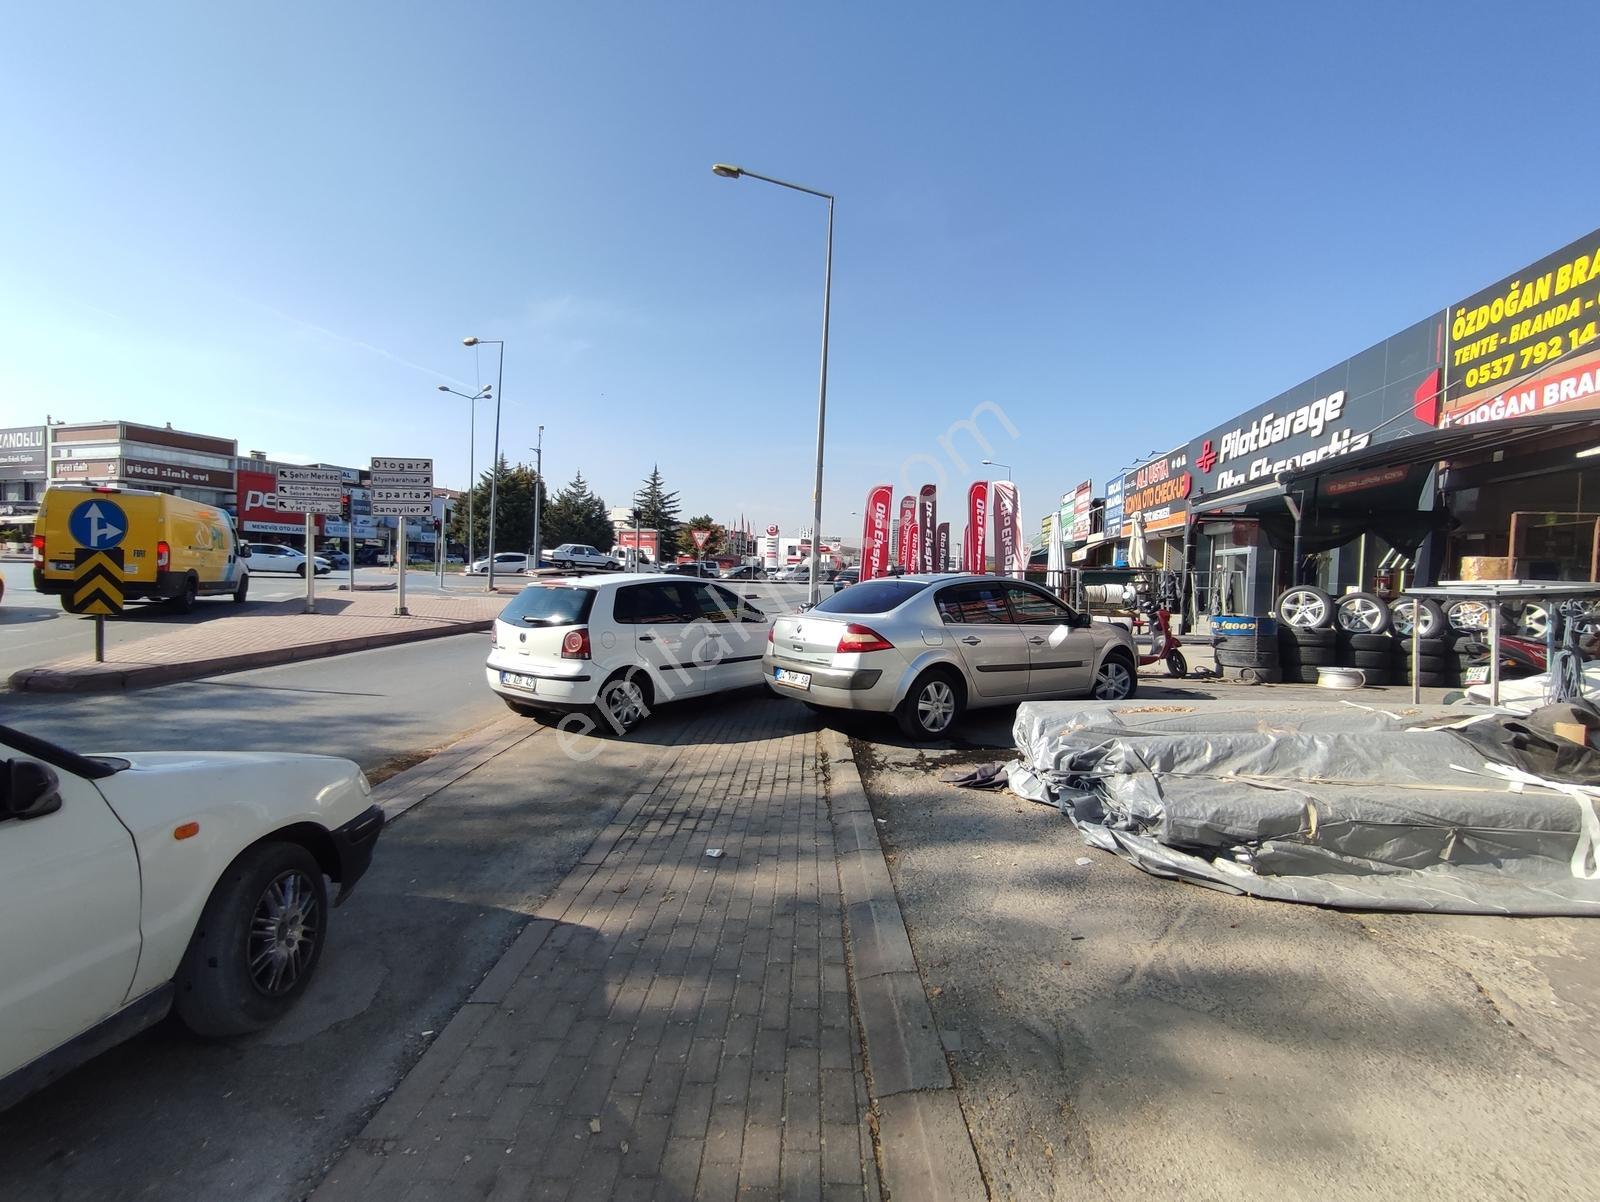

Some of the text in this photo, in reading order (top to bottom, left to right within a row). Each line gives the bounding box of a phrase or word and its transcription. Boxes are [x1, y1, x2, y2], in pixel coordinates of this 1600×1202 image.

[1452, 273, 1552, 341] ÖZDOĞAN
[1454, 332, 1499, 366] TENTE
[1509, 297, 1581, 344] BRANDA
[1465, 354, 1515, 388] 0537
[1520, 335, 1563, 369] 792
[374, 460, 421, 471] Otogar
[373, 490, 420, 500] Isparta
[373, 505, 420, 514] Sanayiler
[875, 503, 886, 528] Oto
[976, 499, 985, 525] Oto
[278, 524, 290, 532] OTO
